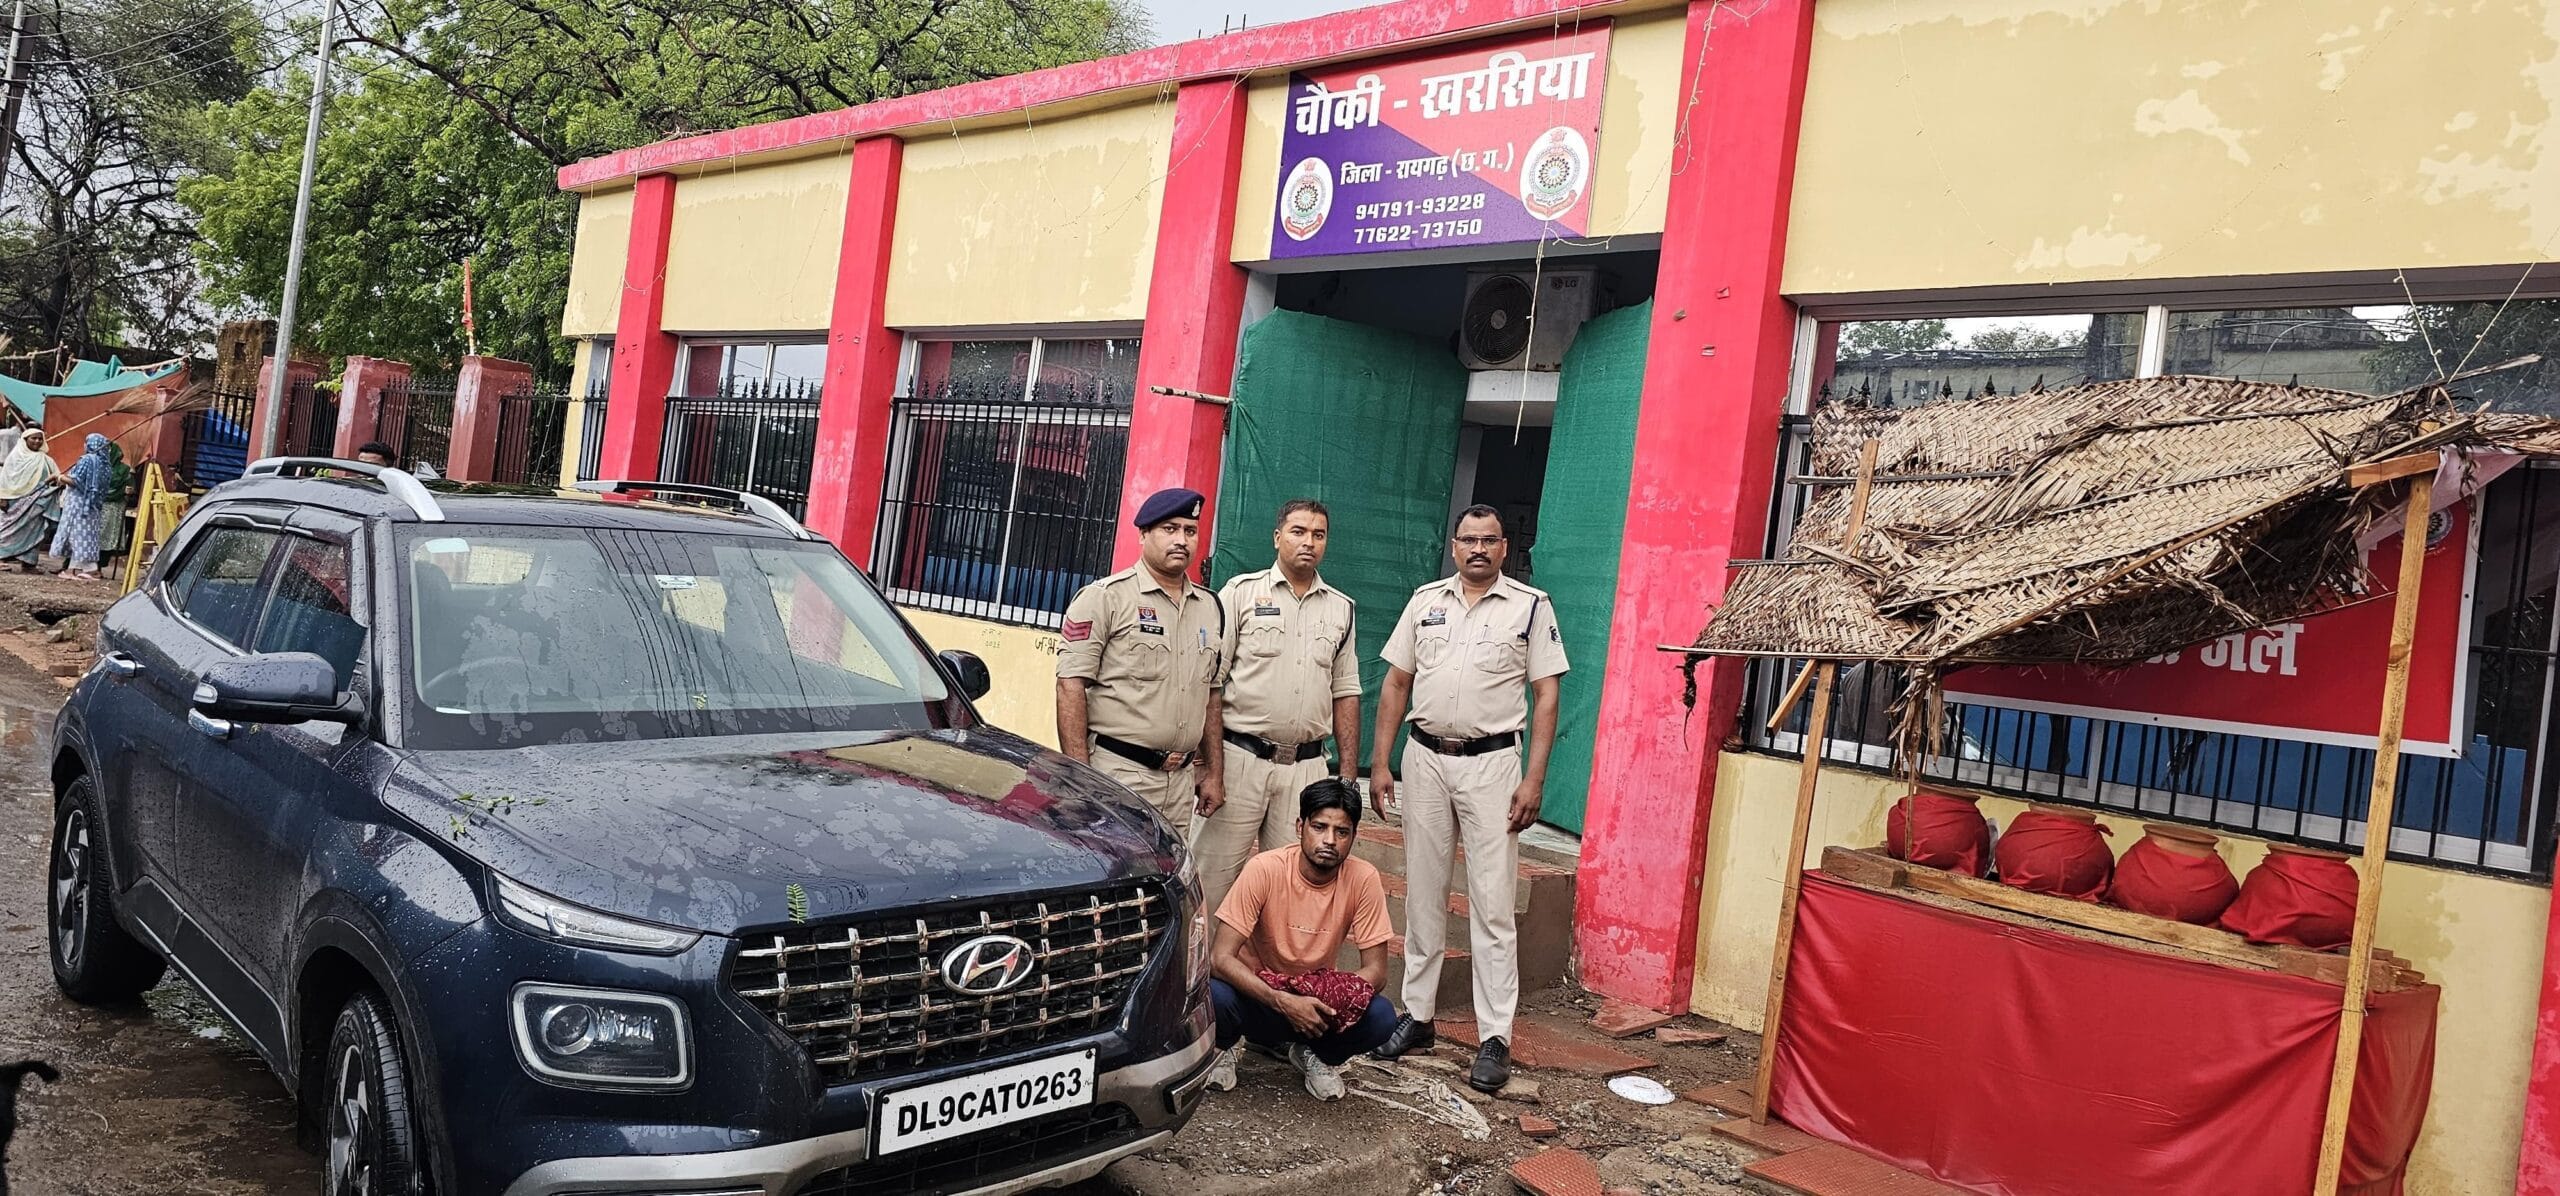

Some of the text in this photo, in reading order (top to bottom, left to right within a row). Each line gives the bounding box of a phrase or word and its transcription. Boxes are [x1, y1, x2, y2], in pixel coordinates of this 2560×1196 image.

[1295, 74, 1386, 136] चौकी
[1420, 51, 1596, 119] खरसिया
[1340, 161, 1383, 185] जिला
[1355, 193, 1486, 221] 94791-93228
[1354, 218, 1483, 244] 77622-73750
[2200, 623, 2305, 676] जल
[897, 1067, 1082, 1137] DL9CAT0263
